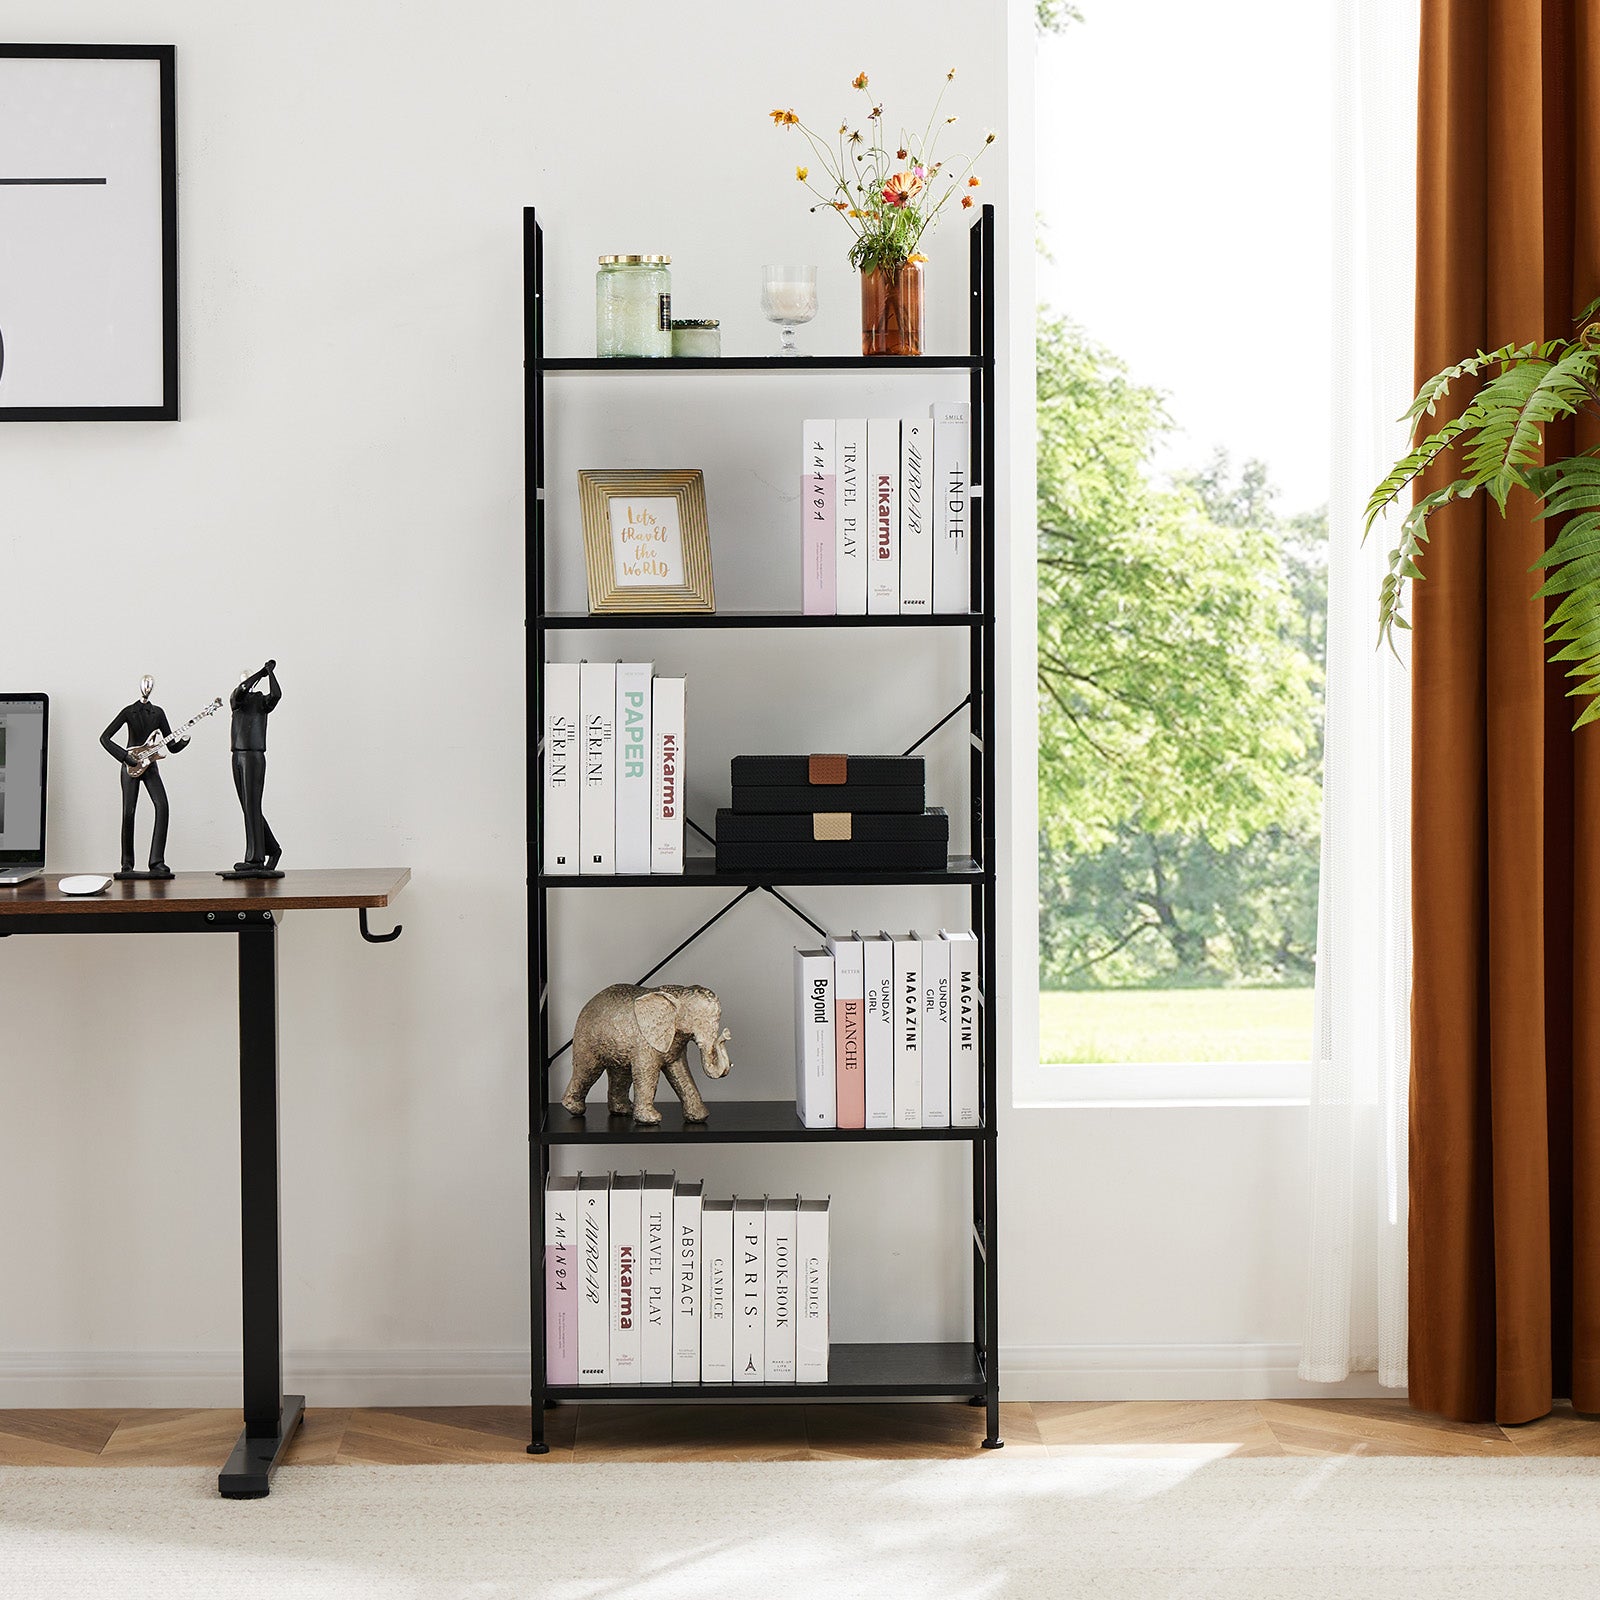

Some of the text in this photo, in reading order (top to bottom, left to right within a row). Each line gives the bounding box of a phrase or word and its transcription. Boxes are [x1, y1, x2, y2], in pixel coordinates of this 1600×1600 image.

[813, 441, 825, 521] AMANDA
[844, 443, 856, 558] TRAVEL PLAY
[878, 476, 893, 559] kikarma
[949, 471, 963, 538] INDIE
[635, 544, 657, 560] the
[552, 715, 566, 788] SERENE
[567, 722, 575, 743] THE
[588, 714, 602, 787] SERENE
[603, 720, 611, 742] THE
[625, 692, 644, 778] PAPER
[663, 735, 678, 817] kikarma
[811, 979, 828, 1023] Beyond
[845, 1002, 857, 1070] BLANCHE
[869, 990, 877, 1013] GIRL
[881, 979, 889, 1024] SUNDAY
[906, 972, 917, 1051] MAGAZINE
[926, 989, 934, 1013] GIRL
[939, 978, 947, 1023] SUNDAY
[961, 971, 972, 1051] MAGAZINE
[555, 1212, 567, 1291] AMANDA
[620, 1247, 636, 1329] kikarma
[650, 1212, 661, 1326] TRAVEL PLAY
[681, 1226, 694, 1316] ABSTRACT
[745, 1235, 758, 1316] PARIS
[776, 1238, 788, 1328] LOOK-BOOK
[713, 1258, 723, 1319] CANDICE
[809, 1258, 818, 1319] CANDICE
